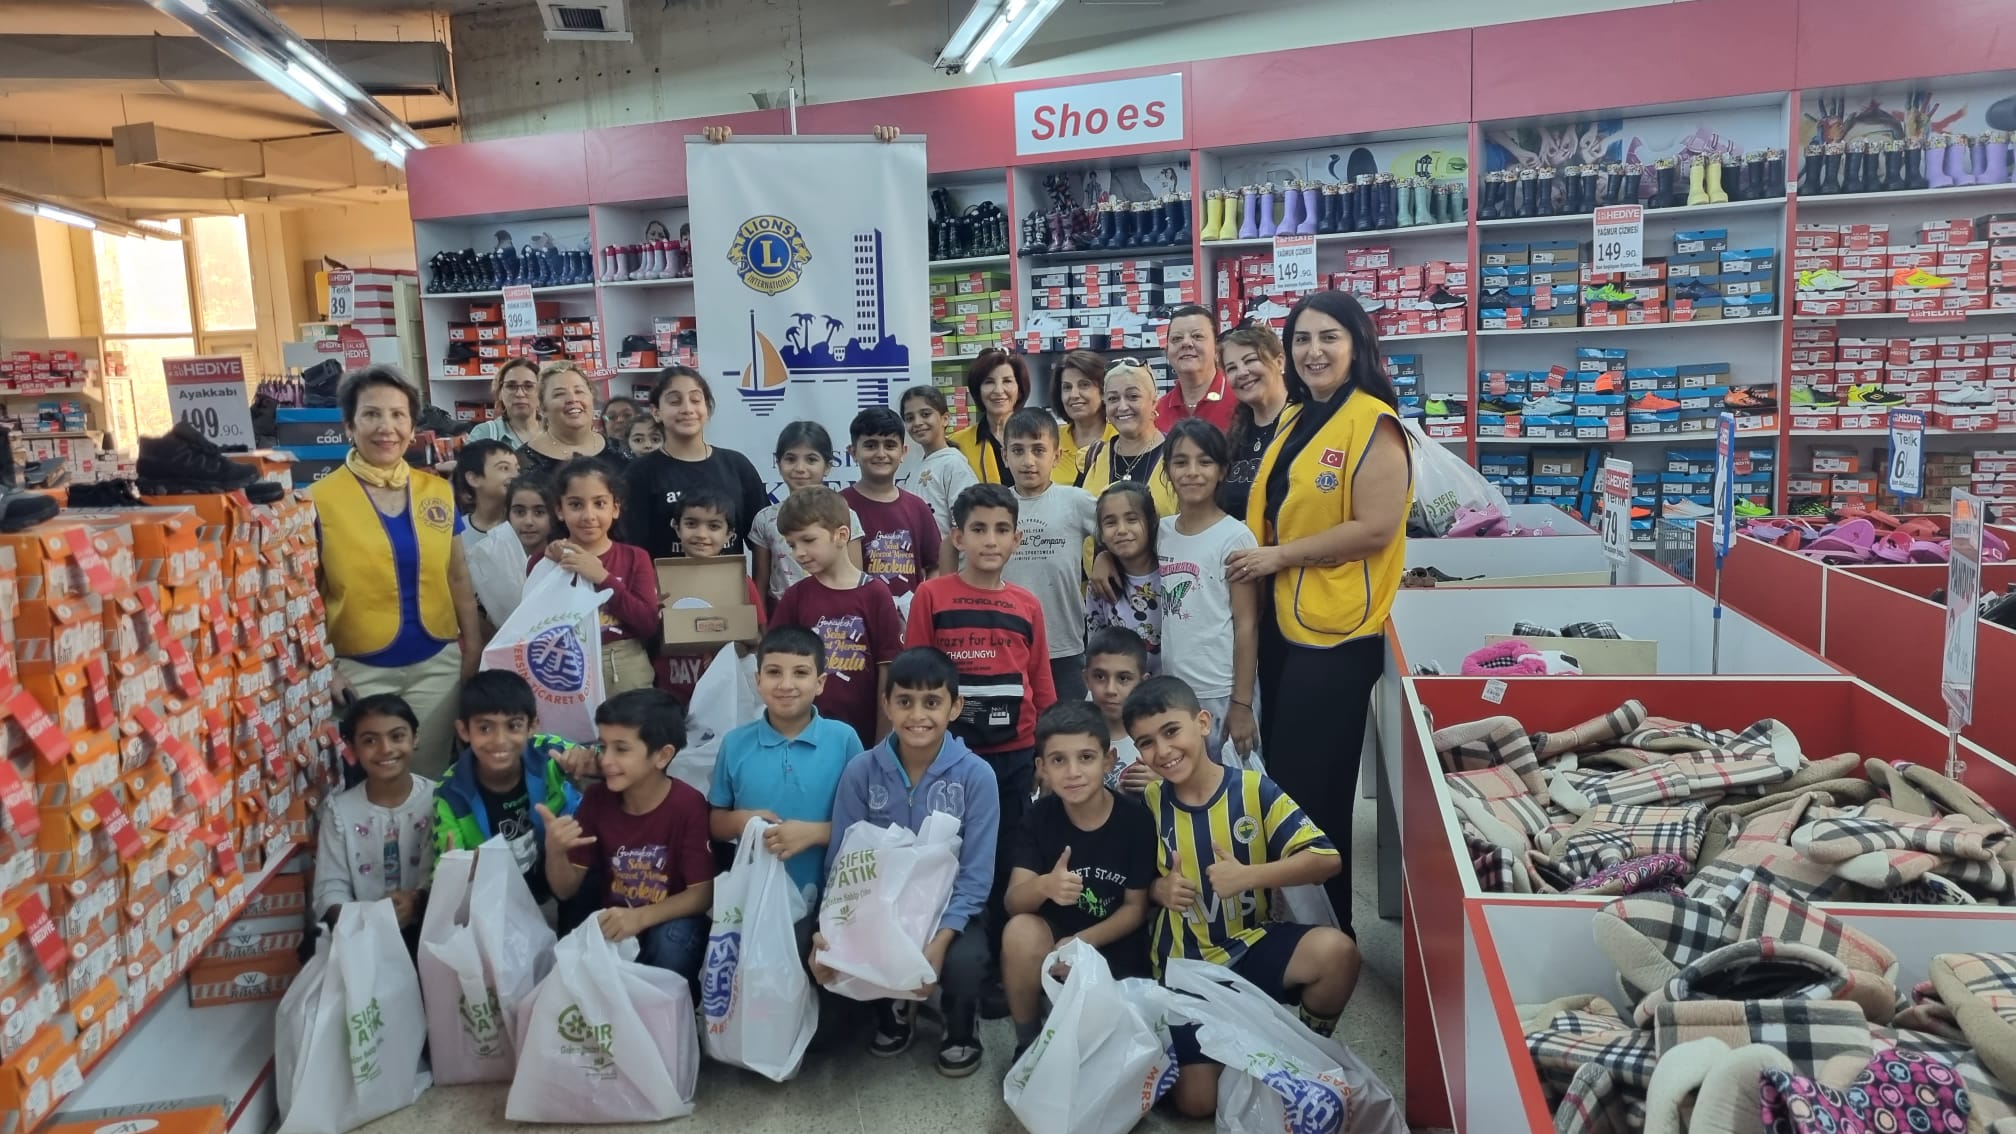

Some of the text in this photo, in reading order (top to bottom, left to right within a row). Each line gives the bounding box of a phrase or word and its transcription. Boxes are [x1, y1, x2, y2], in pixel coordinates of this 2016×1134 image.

[1031, 100, 1166, 141] Shoes
[743, 218, 793, 236] LIONS
[760, 240, 782, 267] L
[1598, 242, 1621, 261] 149
[1278, 262, 1298, 280] 149
[747, 274, 794, 290] INTERNATIONAL
[331, 297, 346, 314] 39
[179, 387, 237, 400] Ayakkabı
[317, 433, 342, 444] cool
[1433, 491, 1456, 508] SIFIR
[1440, 500, 1461, 516] ATIK
[1604, 510, 1618, 546] 79
[1029, 535, 1066, 549] Company
[969, 633, 987, 648] for
[839, 848, 876, 871] SIFIR
[838, 862, 878, 889] ATIK
[1094, 867, 1127, 886] START
[243, 972, 259, 985] W
